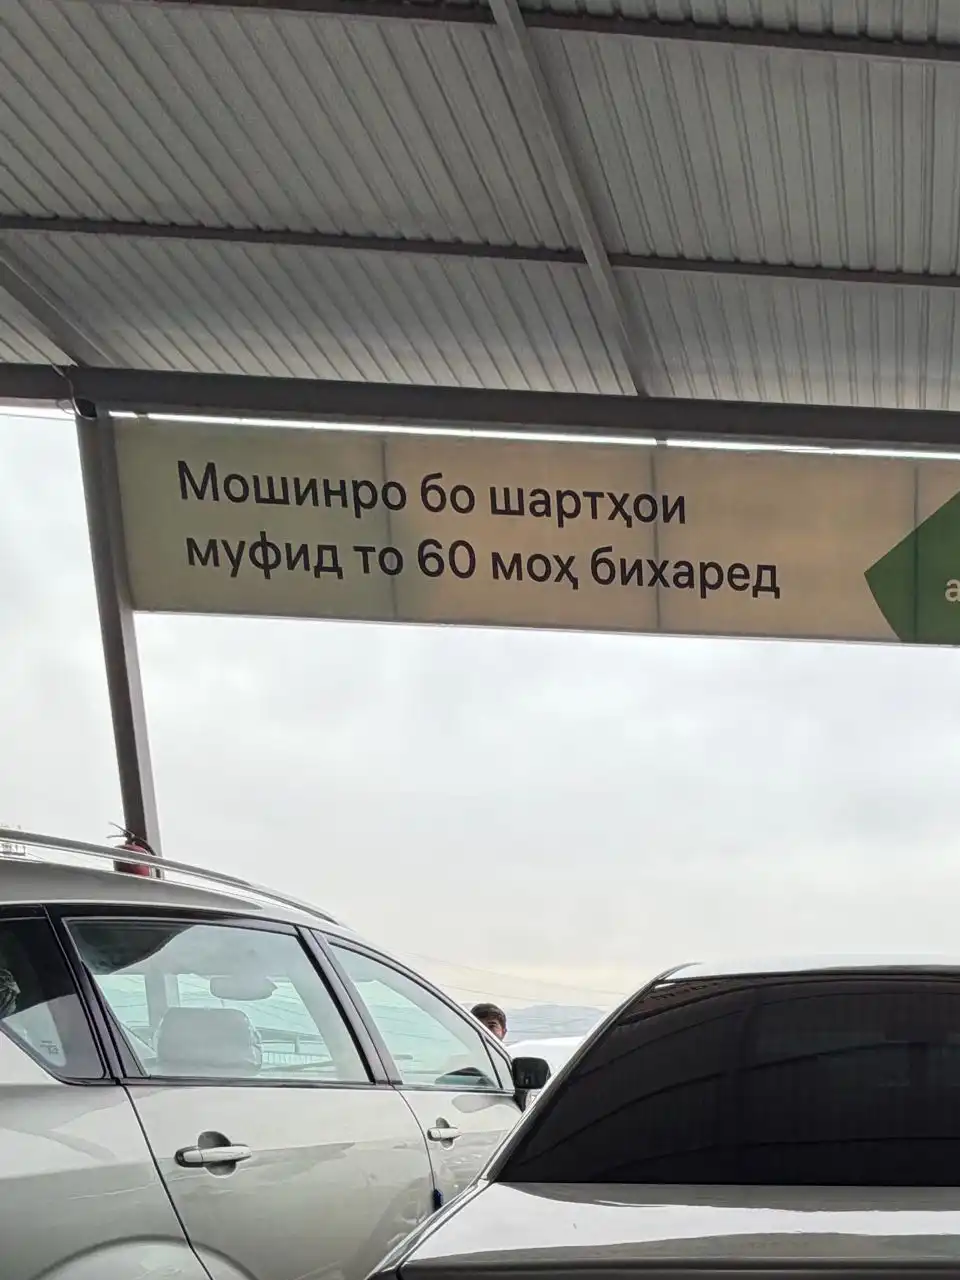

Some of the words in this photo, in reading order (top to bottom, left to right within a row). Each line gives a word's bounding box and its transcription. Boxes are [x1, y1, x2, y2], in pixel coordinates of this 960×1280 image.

[177, 459, 407, 518] Мошинро
[420, 472, 476, 515] бо
[490, 484, 687, 528] шартҳои
[186, 531, 344, 580] муфид
[353, 542, 404, 577] то
[417, 539, 476, 580] 60
[491, 551, 578, 591] моҳ
[590, 545, 781, 600] бихаред
